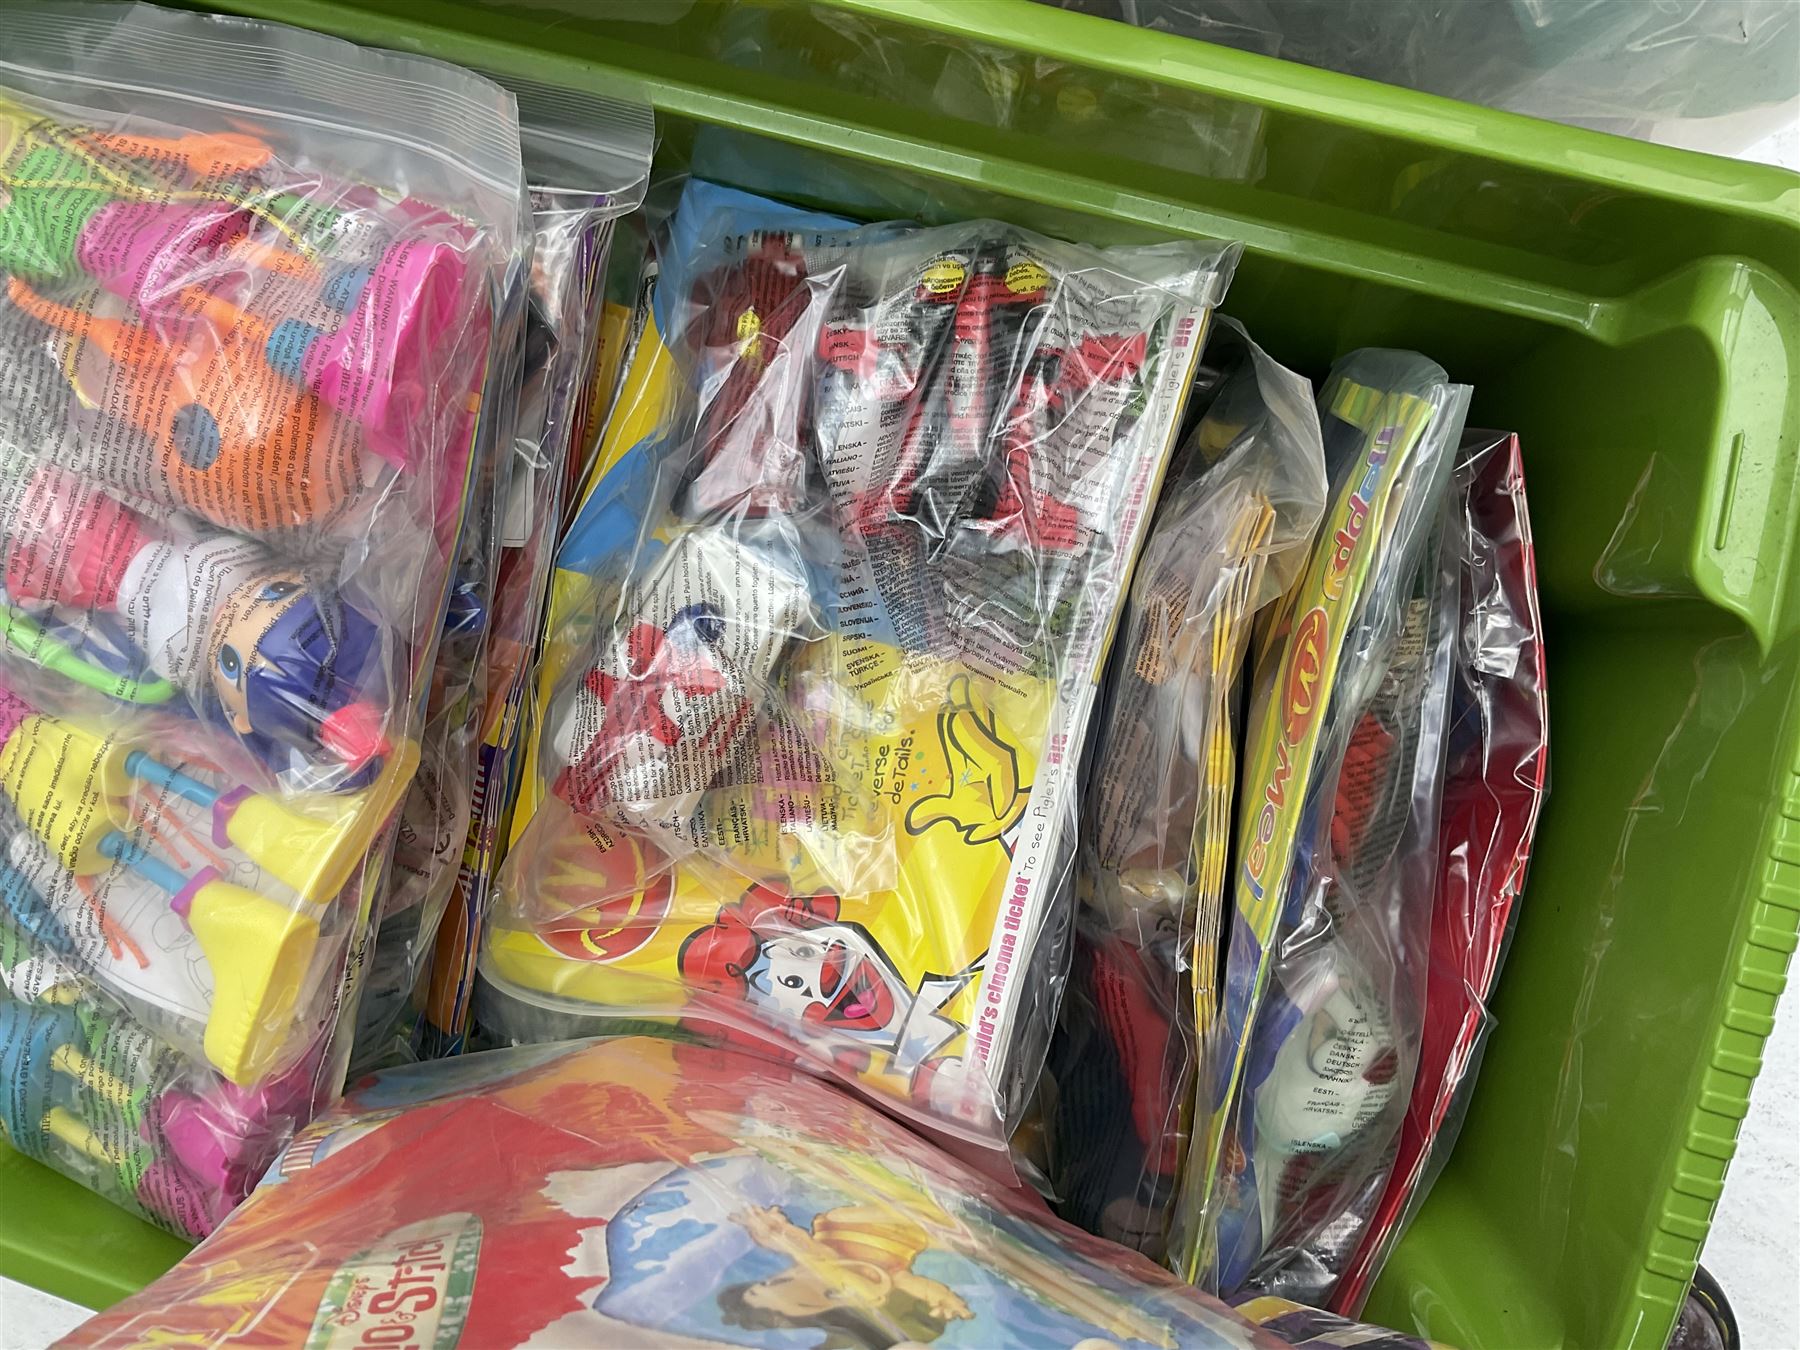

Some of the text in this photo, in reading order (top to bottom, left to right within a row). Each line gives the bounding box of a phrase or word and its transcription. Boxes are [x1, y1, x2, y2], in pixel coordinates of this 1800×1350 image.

[276, 396, 289, 437] možnost
[308, 395, 319, 432] posibles
[289, 415, 302, 460] problemes
[301, 433, 314, 479] problemas
[847, 652, 880, 670] SVENSKA
[717, 823, 726, 846] EESTI
[731, 806, 742, 843] FRANÇAIS
[740, 804, 750, 841] HRVATSKI
[1242, 740, 1291, 900] Meal
[588, 829, 607, 853] ENGLISH
[974, 1007, 998, 1062] hild's
[987, 933, 1016, 1004] cinema
[1024, 856, 1036, 870] To
[1031, 823, 1045, 848] see
[1047, 734, 1068, 764] BIG
[1313, 1087, 1335, 1096] EESTI
